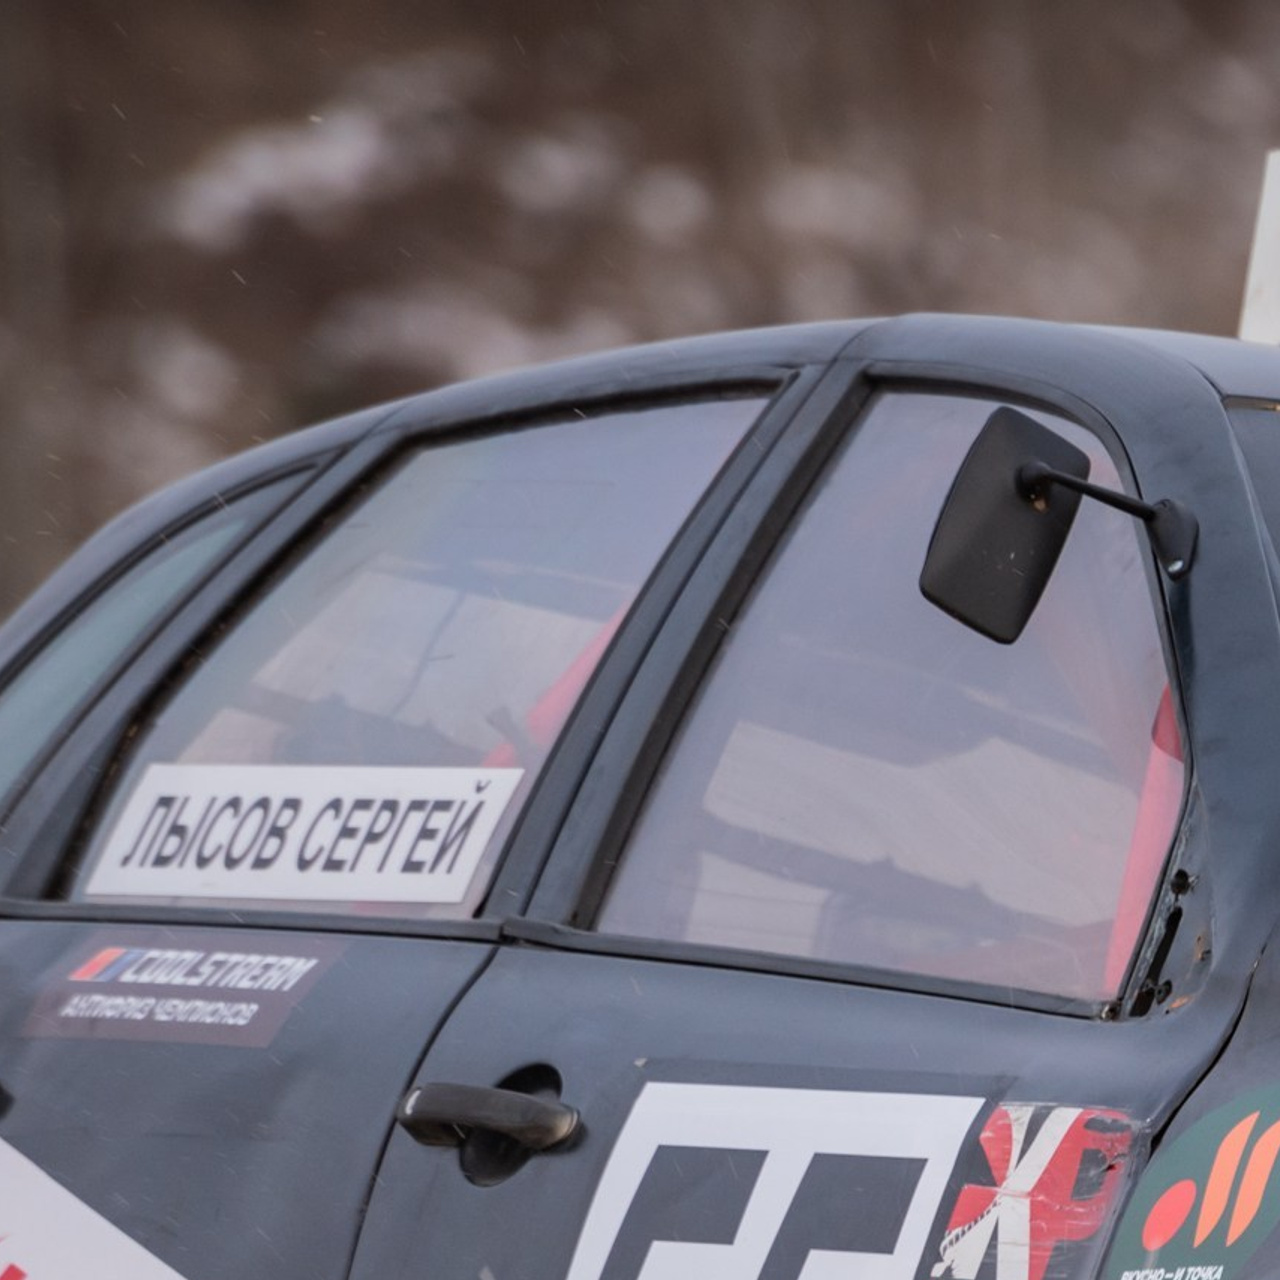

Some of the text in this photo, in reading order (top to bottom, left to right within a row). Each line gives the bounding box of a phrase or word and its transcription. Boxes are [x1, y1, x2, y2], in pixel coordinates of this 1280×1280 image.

[120, 779, 492, 875] ЛЫСОВ СЕРГЕЙ
[119, 948, 319, 992] COOLSTREAM
